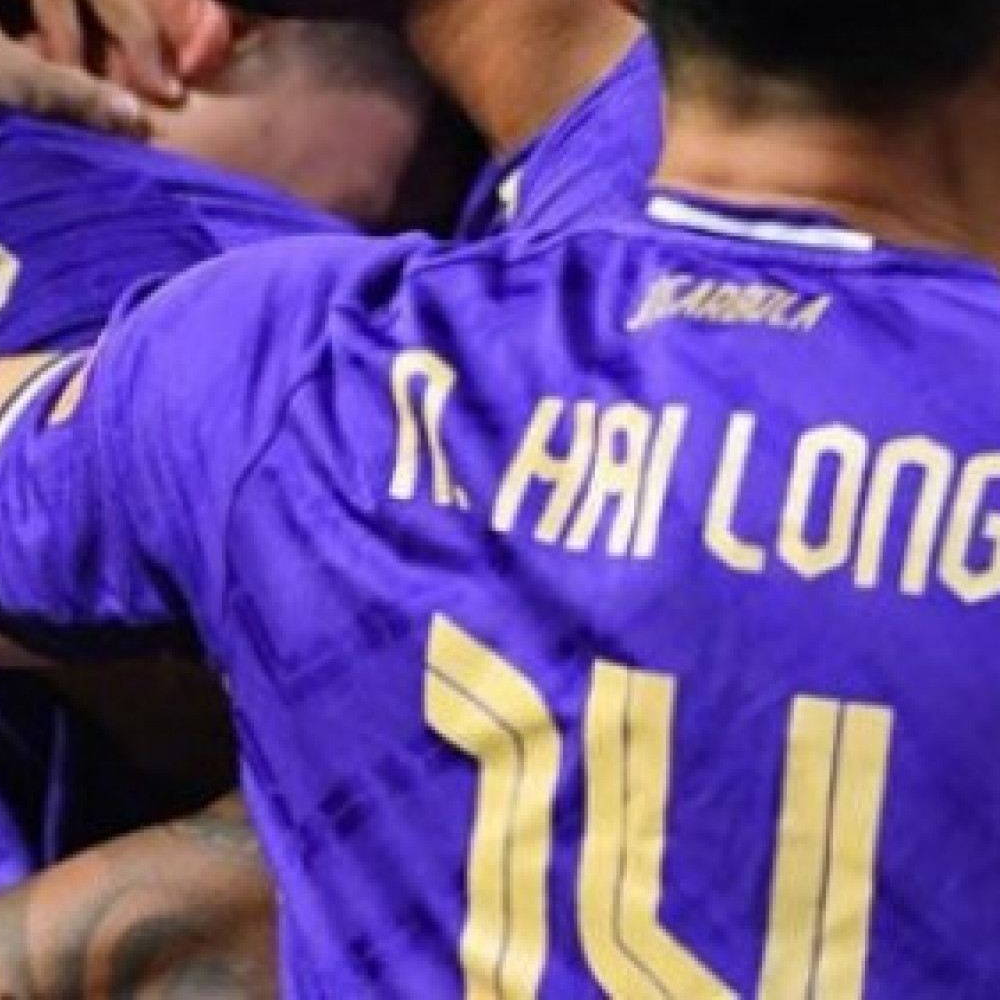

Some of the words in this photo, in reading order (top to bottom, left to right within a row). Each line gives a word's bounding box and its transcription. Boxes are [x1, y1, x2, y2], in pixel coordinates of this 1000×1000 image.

[490, 395, 689, 560] HAI
[703, 410, 1000, 603] LONG
[424, 612, 894, 1000] 14
